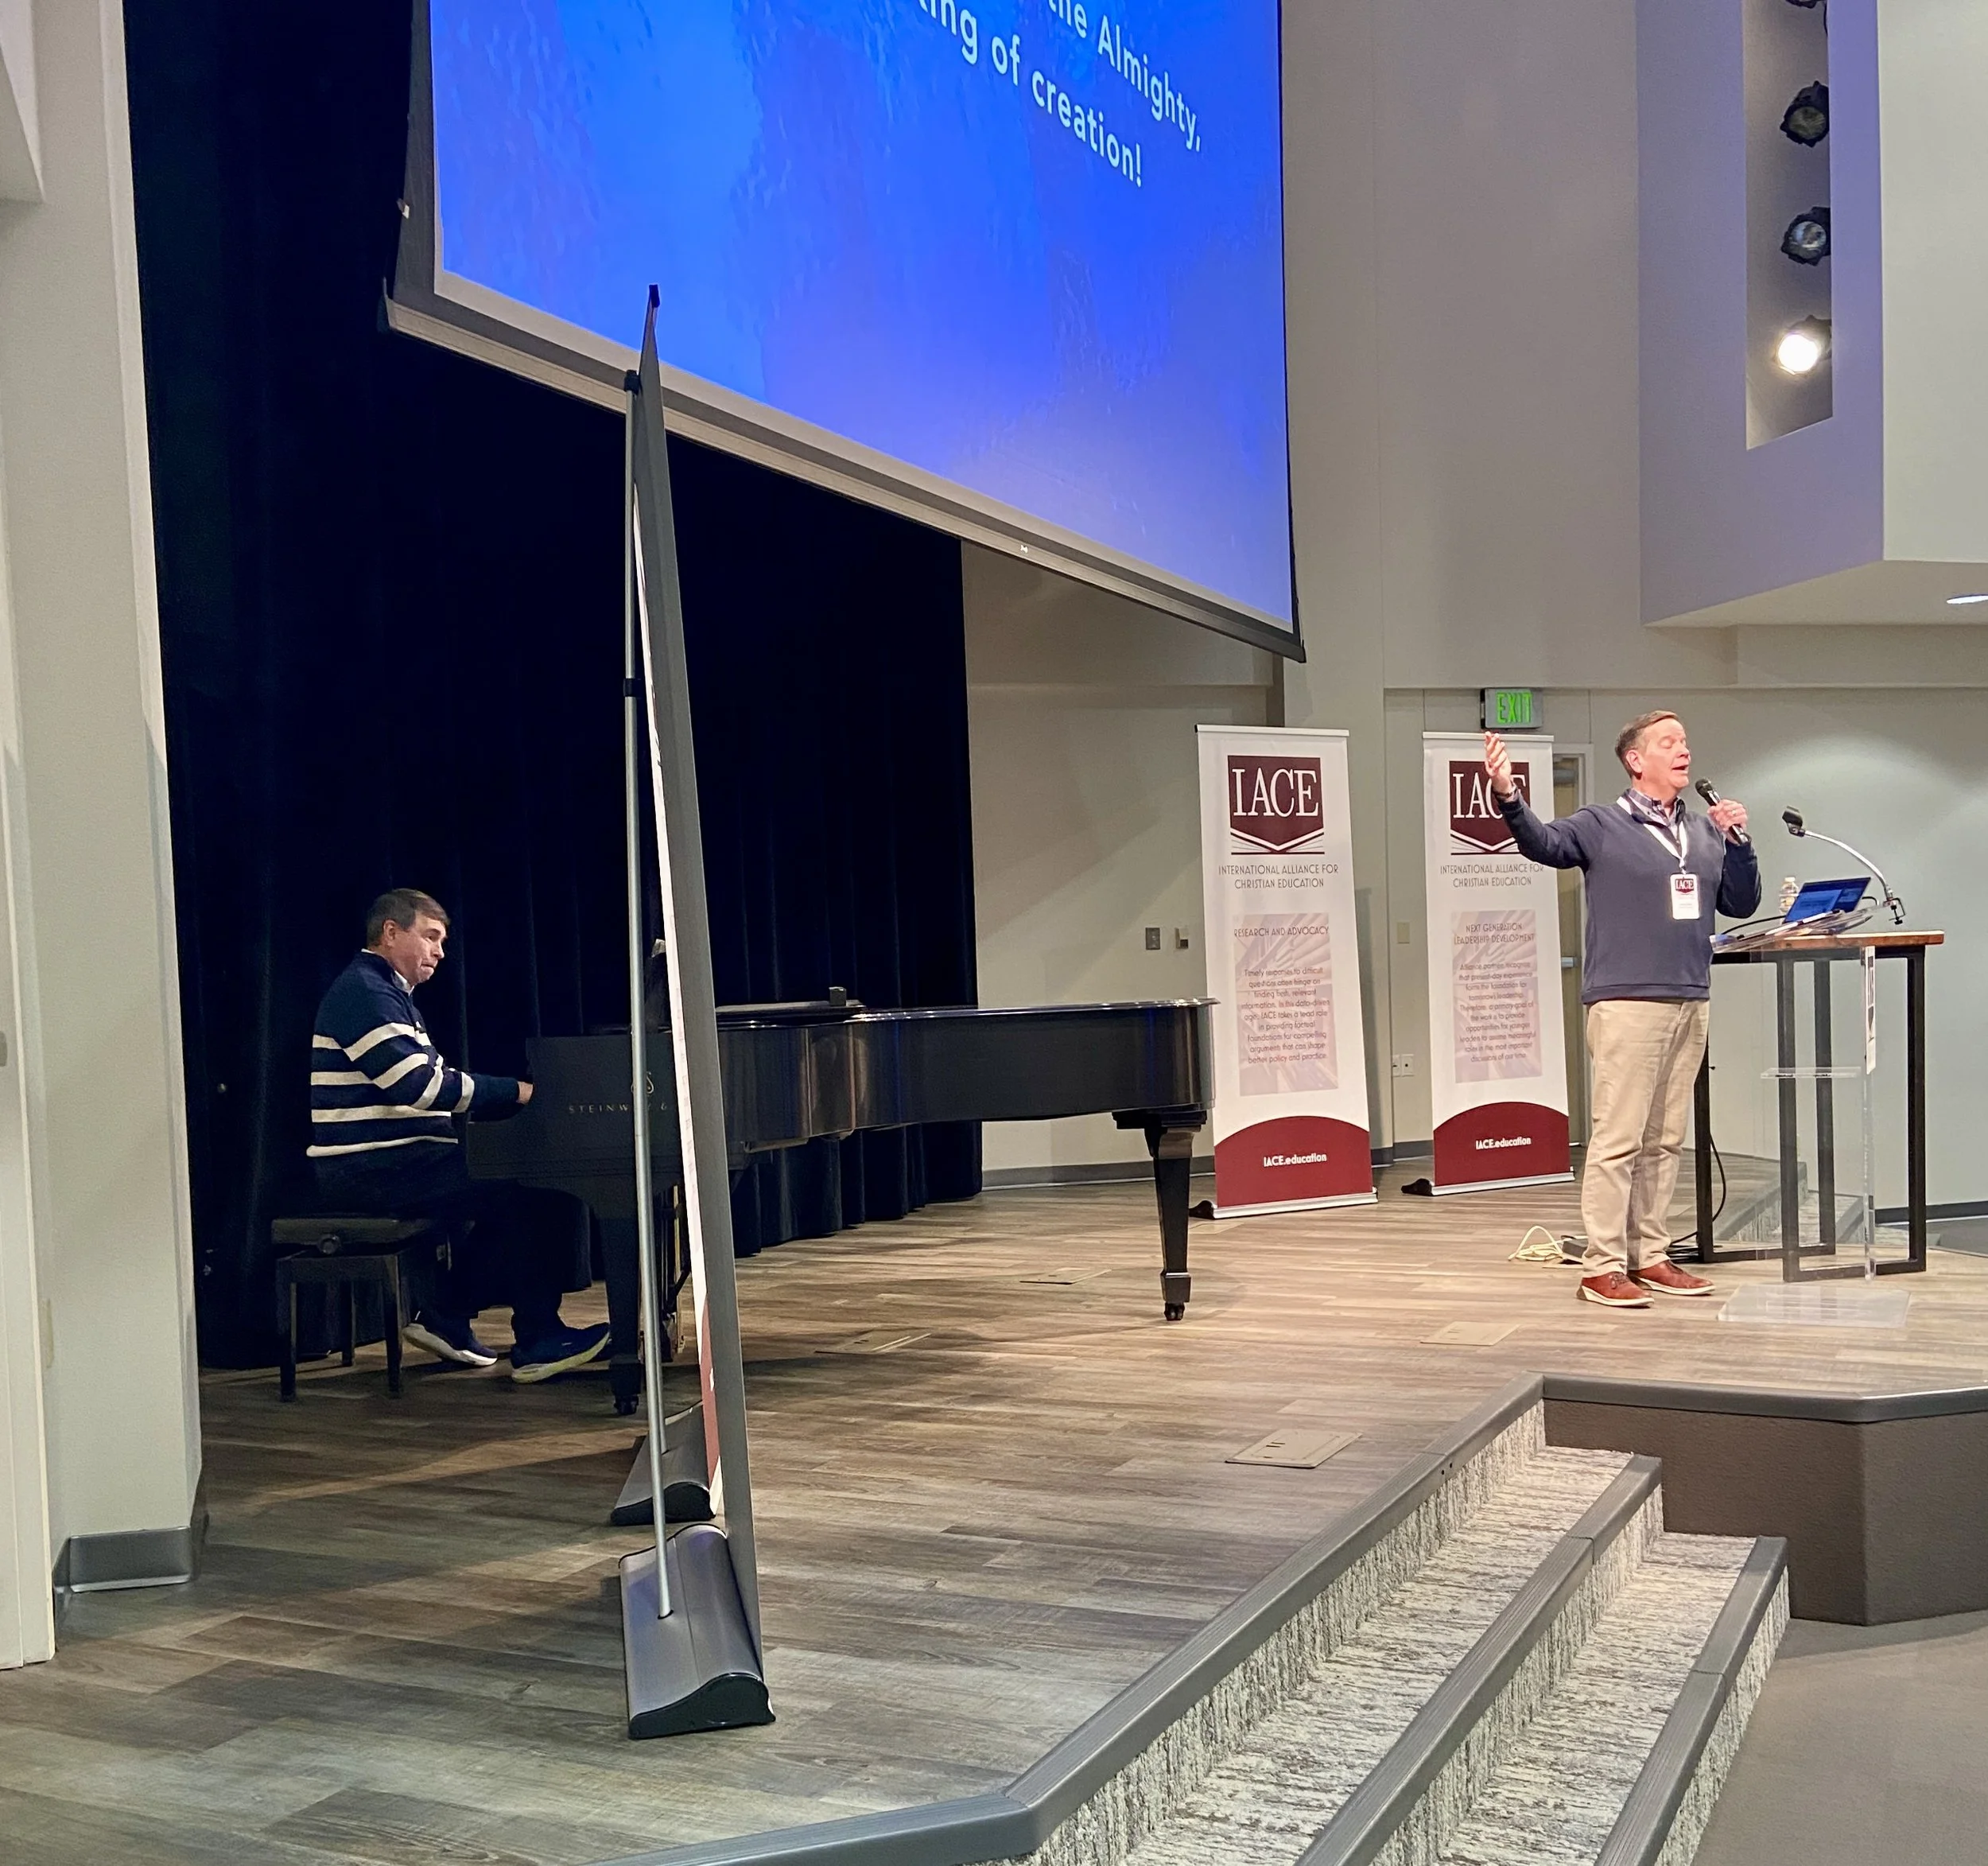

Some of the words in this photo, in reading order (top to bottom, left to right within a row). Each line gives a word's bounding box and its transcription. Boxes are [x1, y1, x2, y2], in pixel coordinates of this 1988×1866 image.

[1097, 14, 1202, 152] Almighty,
[918, 0, 977, 64] ing
[991, 33, 1021, 87] of
[1031, 70, 1143, 188] creation!
[1496, 691, 1532, 724] EXIT
[1232, 768, 1319, 818] IACE
[1218, 865, 1279, 876] INTERNATIONAL
[1282, 864, 1319, 874] ALLIANCE
[1322, 864, 1339, 873] FOR
[1440, 865, 1493, 874] INTERNATIONAL
[1495, 863, 1528, 873] ALLIANCE
[1529, 863, 1543, 873] FOR
[1234, 878, 1275, 889] CHRISTIAN
[1278, 877, 1324, 888] EDUCATION
[1453, 877, 1489, 888] CHRISTIAN
[1492, 877, 1532, 887] EDUCATION
[1675, 880, 1694, 889] IACE
[1234, 928, 1269, 937] RESEARCH
[1272, 927, 1286, 936] AND
[1287, 926, 1329, 935] ADVOCACY
[1466, 923, 1481, 933] NEXT
[1482, 922, 1522, 932] GENERATION
[1454, 935, 1489, 945] LEADERSHIP
[1491, 933, 1535, 943] DEVELOPMENT
[1244, 969, 1264, 978] Timely
[1248, 980, 1276, 989] questions
[1254, 989, 1275, 999] finding
[1291, 988, 1316, 997] relevant
[1295, 999, 1330, 1008] data-driven
[1266, 1021, 1293, 1032] providing
[1269, 1054, 1287, 1063] policy
[1475, 1137, 1532, 1150] IACE.education
[1264, 1153, 1327, 1168] IACE.education
